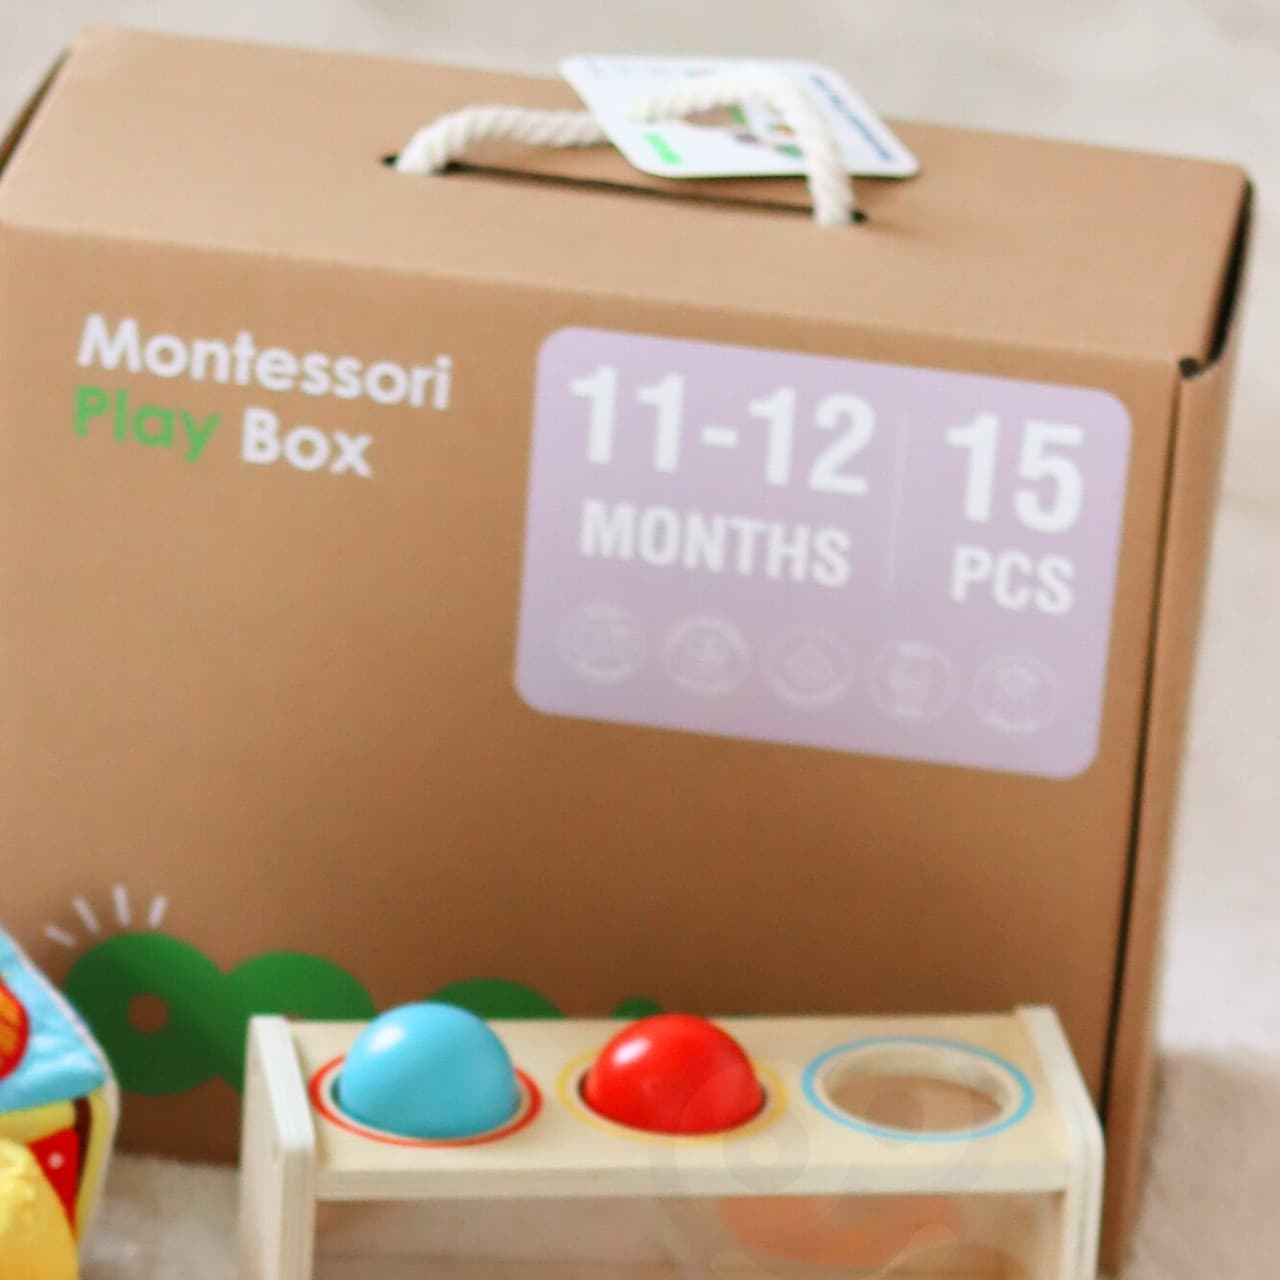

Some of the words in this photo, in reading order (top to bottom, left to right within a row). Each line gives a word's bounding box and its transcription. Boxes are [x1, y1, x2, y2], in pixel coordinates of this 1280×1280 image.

[77, 313, 452, 410] Montessori
[73, 386, 220, 464] Play
[240, 405, 374, 478] Box
[568, 365, 877, 497] 11-12
[945, 412, 1087, 534] 15
[578, 499, 853, 589] MONTHS
[949, 545, 1076, 616] PCS
